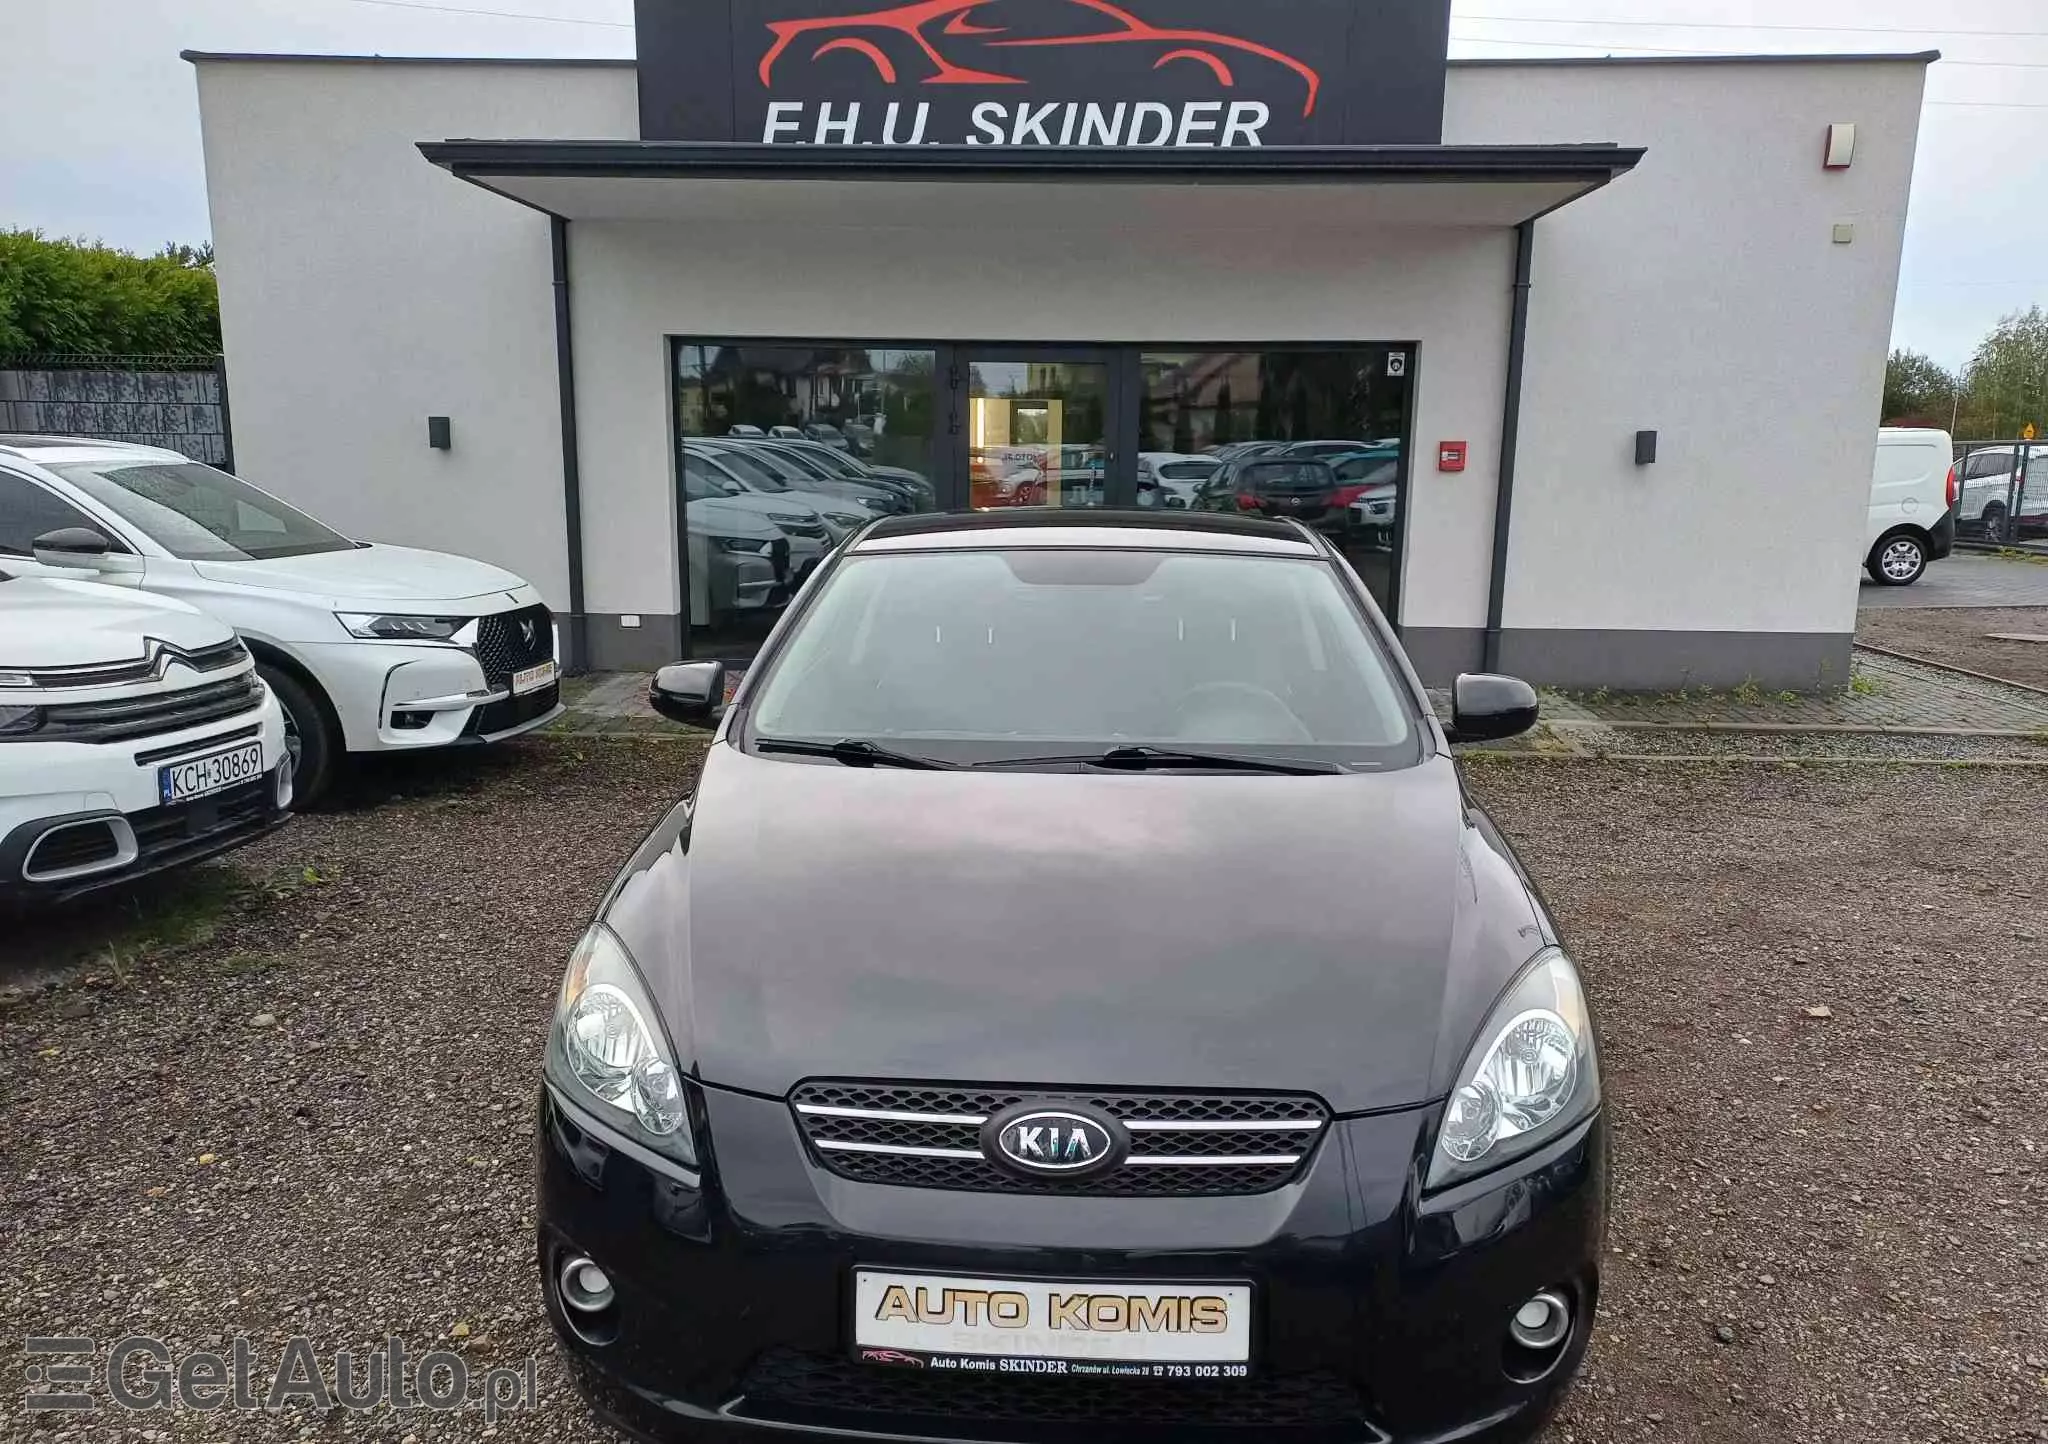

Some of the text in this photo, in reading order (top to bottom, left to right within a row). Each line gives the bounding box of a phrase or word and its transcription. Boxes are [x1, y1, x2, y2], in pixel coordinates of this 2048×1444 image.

[965, 101, 1271, 147] SKINDER
[172, 762, 208, 797] KCH
[213, 748, 259, 784] 30869
[1018, 1126, 1092, 1158] KIA
[875, 1284, 1229, 1334] AUTO KOMIS
[930, 1356, 957, 1369] Auto
[960, 1358, 996, 1371] Komis
[999, 1358, 1069, 1374] SKINDER
[1167, 1365, 1191, 1377] 793
[1195, 1365, 1220, 1377] 002
[1223, 1365, 1248, 1378] 309
